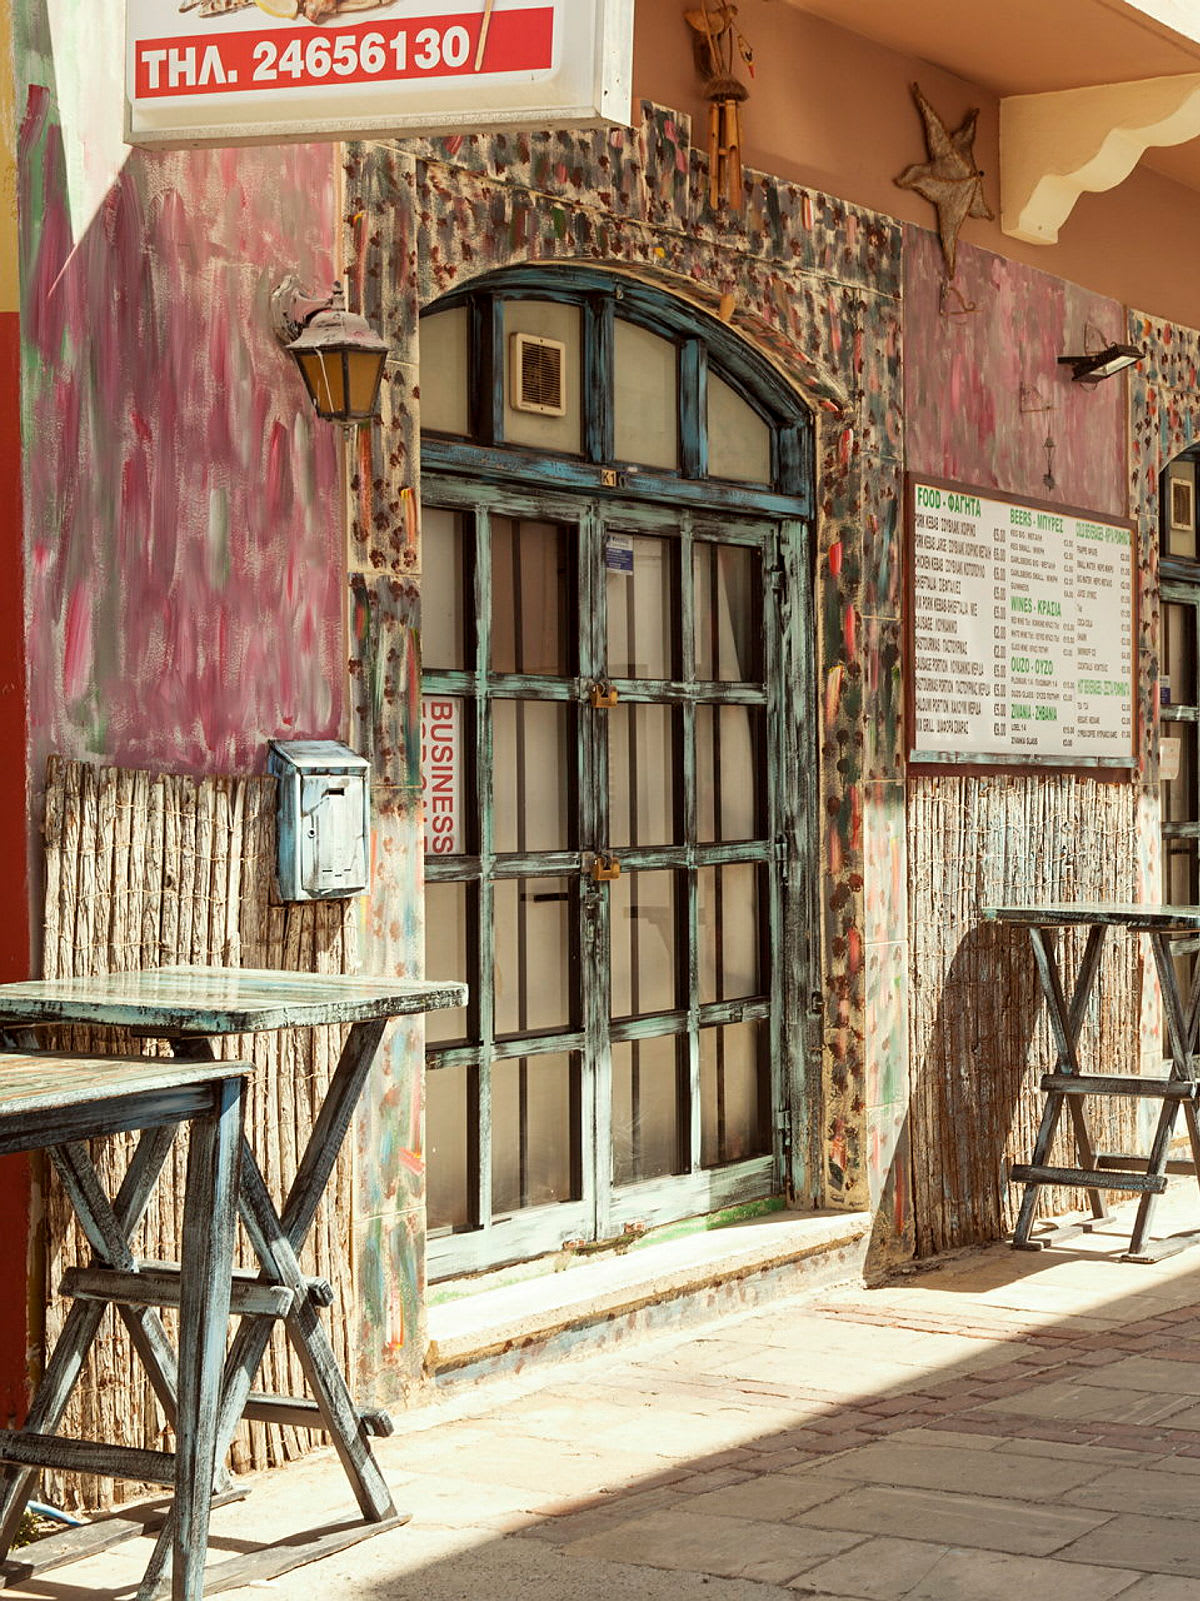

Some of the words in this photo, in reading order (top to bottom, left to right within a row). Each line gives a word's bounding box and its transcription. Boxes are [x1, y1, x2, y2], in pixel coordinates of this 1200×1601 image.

[141, 45, 239, 89] ΤΗΛ.
[252, 26, 471, 82] 24656130
[917, 486, 941, 509] FOOD
[947, 494, 982, 518] ΦΑΓΗΤΑ
[1010, 508, 1032, 527] BEERS
[1010, 596, 1033, 614] WINES
[1037, 599, 1062, 617] ΚΡΑΣΙΑ
[1010, 656, 1030, 673] OUZO
[430, 701, 454, 854] BUSINESS
